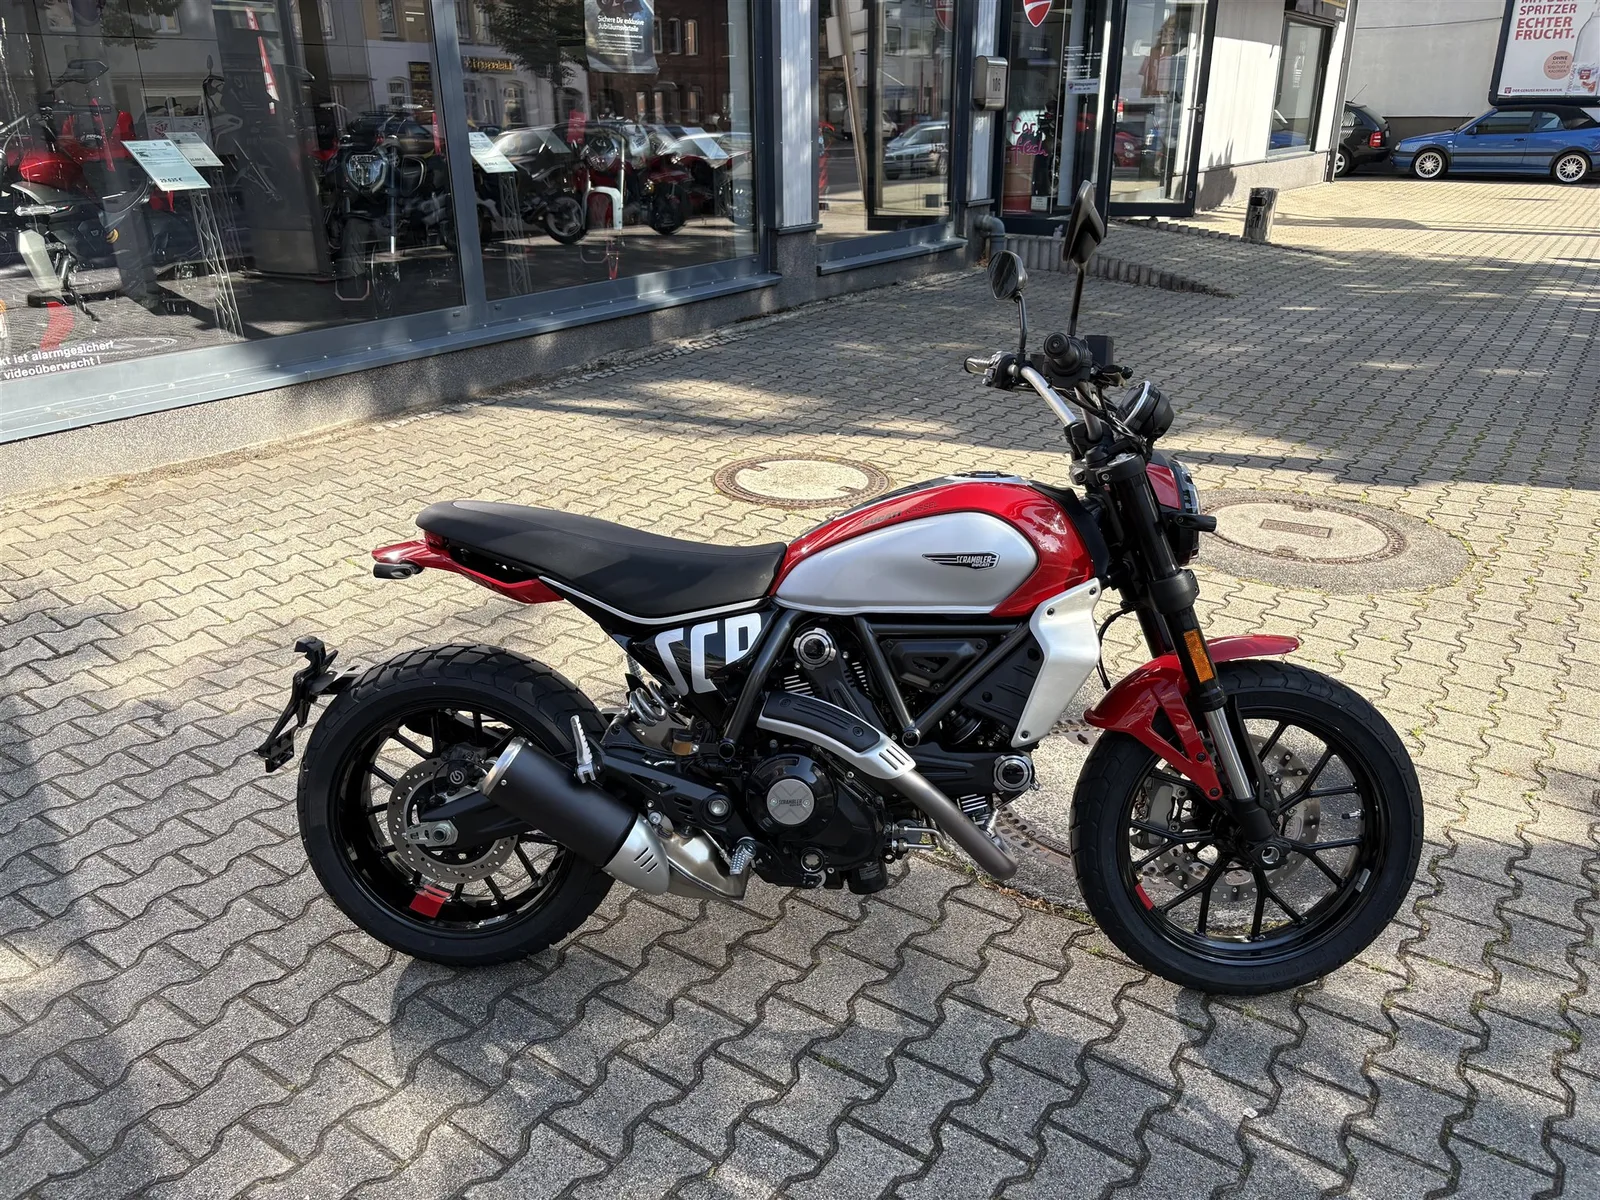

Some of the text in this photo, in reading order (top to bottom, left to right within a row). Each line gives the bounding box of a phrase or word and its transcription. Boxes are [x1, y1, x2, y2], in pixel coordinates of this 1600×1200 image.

[1519, 4, 1577, 15] SPRITZER
[597, 15, 615, 23] Sichere
[616, 16, 624, 24] Dir
[1517, 17, 1573, 28] ECHTER
[1514, 28, 1575, 40] FRUCHT.
[992, 77, 1001, 92] 106
[13, 353, 29, 364] ist
[31, 339, 114, 362] alarmgesichert
[4, 357, 95, 380] videoüberwacht
[956, 555, 992, 564] SCRAMBLER
